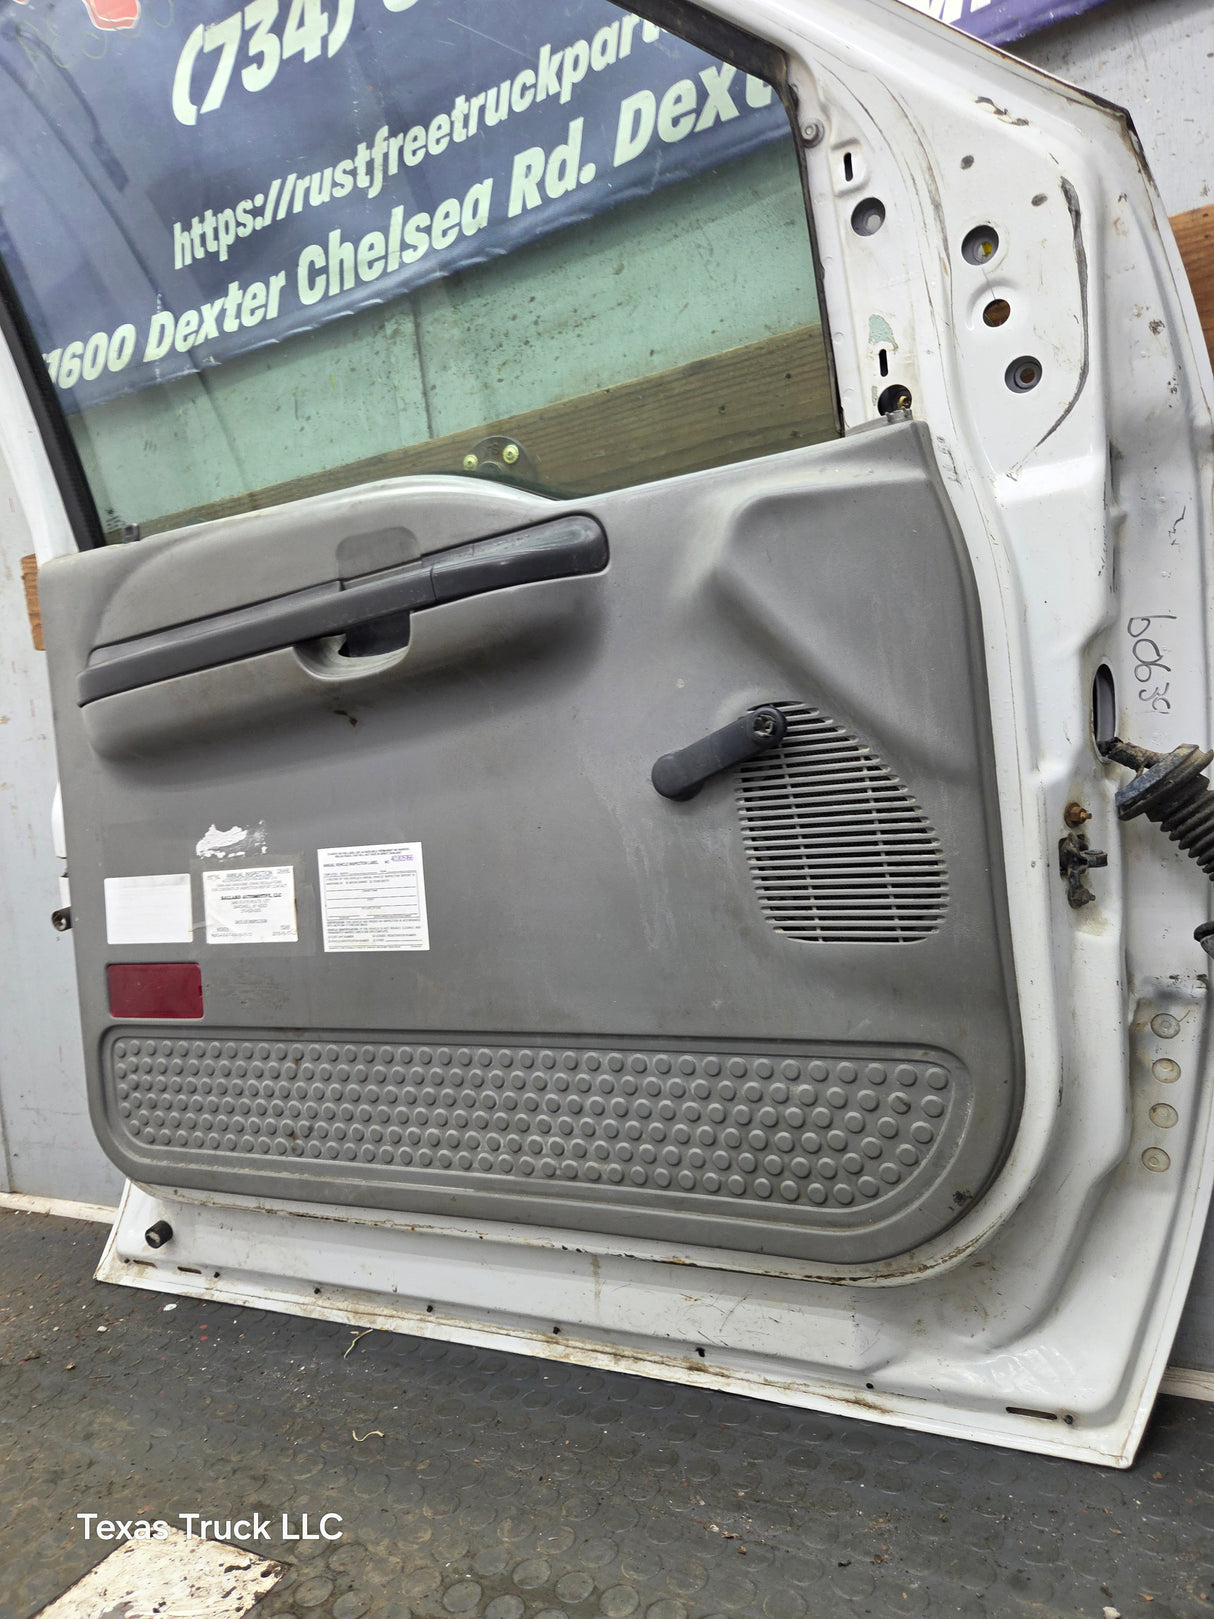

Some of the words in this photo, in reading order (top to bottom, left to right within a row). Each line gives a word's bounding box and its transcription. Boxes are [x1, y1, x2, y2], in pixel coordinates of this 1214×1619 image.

[172, 0, 355, 126] (734)
[173, 13, 667, 270] https://rustfreetruckpar
[143, 270, 286, 363] Dexter
[297, 177, 493, 305] Chelsea
[508, 116, 596, 218] Rd.
